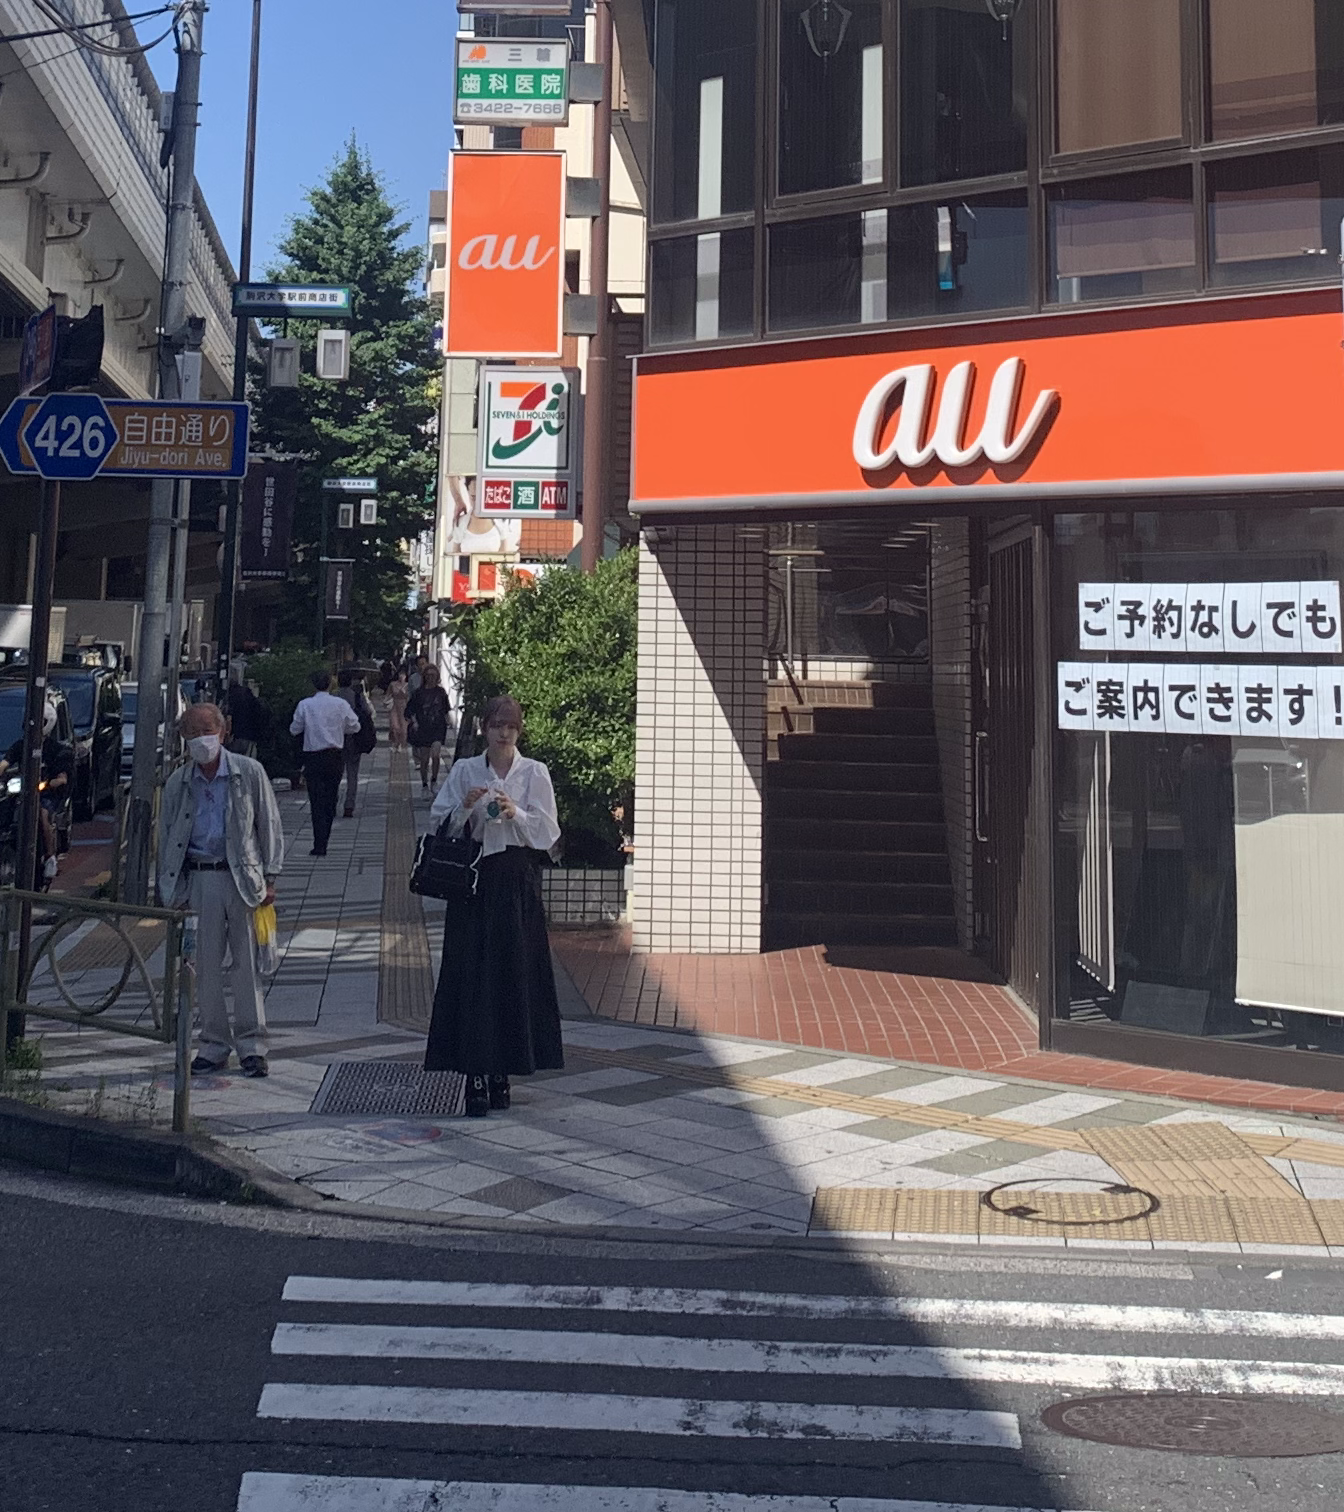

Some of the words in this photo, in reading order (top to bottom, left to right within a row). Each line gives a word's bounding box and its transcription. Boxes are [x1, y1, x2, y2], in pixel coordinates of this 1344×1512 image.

[461, 72, 561, 94] 歯科医院
[458, 233, 556, 271] au
[526, 411, 565, 420] HOLDINGS
[852, 355, 1058, 471] au
[34, 414, 106, 459] 426
[123, 412, 231, 447] 自由通り
[120, 446, 188, 468] Jiyu-dori
[194, 448, 228, 468] Ave.
[484, 485, 511, 504] たばこ
[517, 485, 535, 506] 酒
[541, 485, 567, 506] ATM
[1082, 597, 1337, 640] ご予約なしでも
